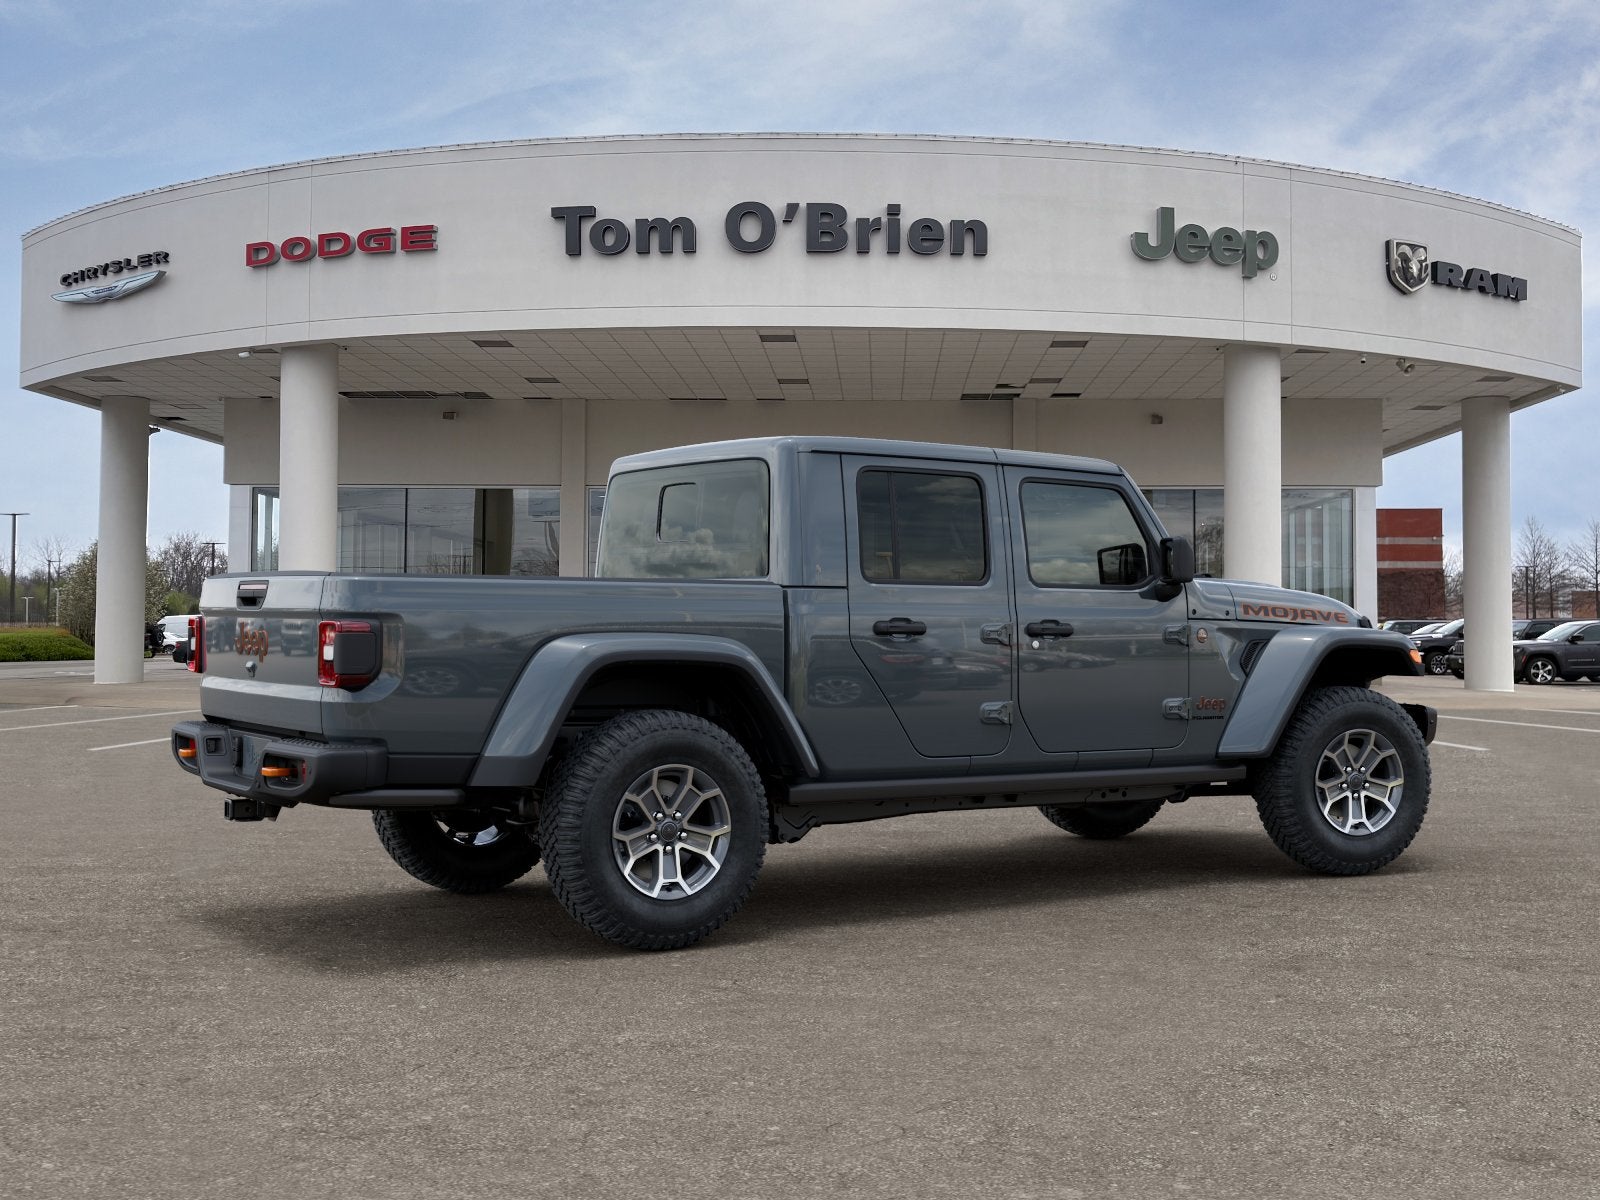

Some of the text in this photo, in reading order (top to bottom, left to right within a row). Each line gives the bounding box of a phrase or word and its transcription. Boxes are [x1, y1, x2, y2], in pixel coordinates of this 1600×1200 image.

[245, 225, 438, 268] DODGE
[551, 201, 988, 256] Tom O'Brien
[1130, 206, 1279, 279] Jeep
[60, 251, 170, 286] CHRYSLER
[1430, 260, 1528, 301] RAM
[1242, 604, 1349, 624] MOJAVE
[234, 621, 269, 663] Jeep
[1195, 695, 1225, 713] Jeep
